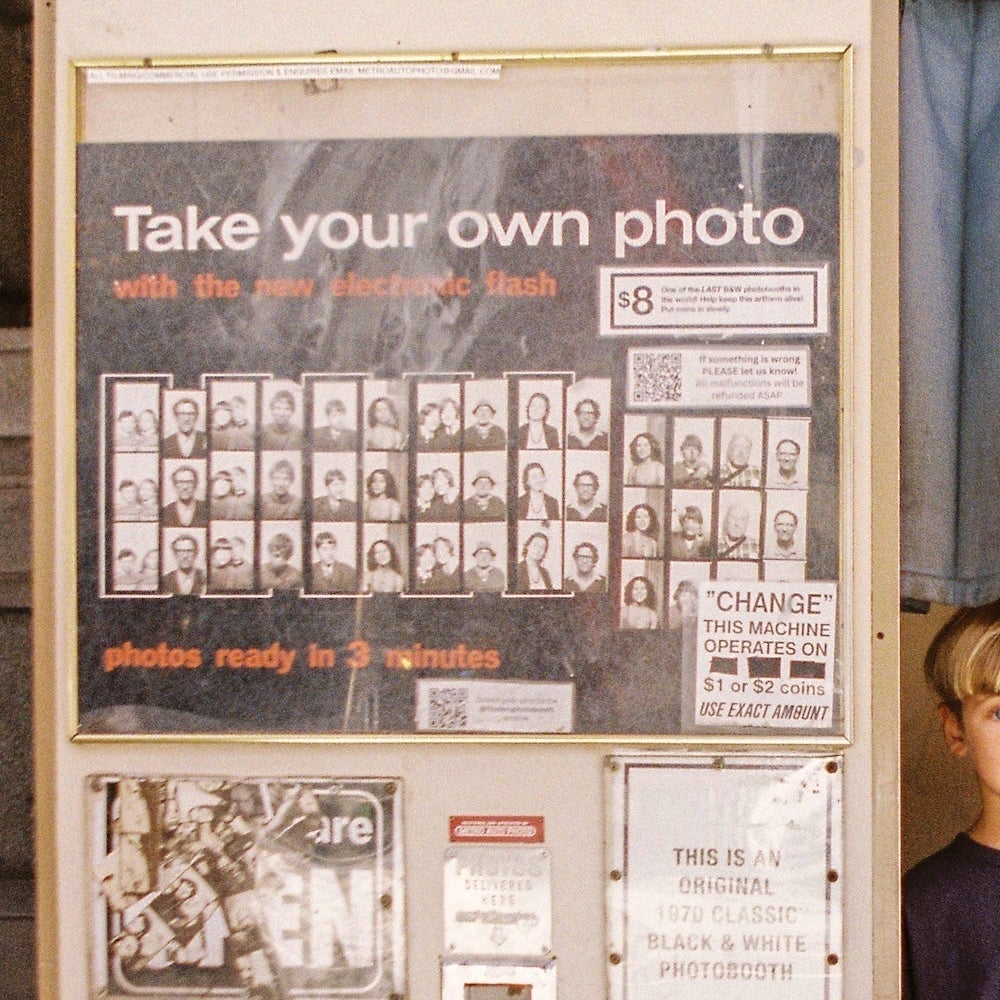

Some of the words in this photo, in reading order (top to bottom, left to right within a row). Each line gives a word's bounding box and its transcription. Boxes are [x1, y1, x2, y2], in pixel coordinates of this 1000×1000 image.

[113, 205, 260, 252] Take
[280, 210, 428, 261] your
[447, 210, 590, 248] own
[615, 199, 805, 258] photo
[113, 273, 178, 298] with
[194, 272, 241, 298] the
[254, 276, 315, 297] new
[331, 270, 471, 296] electronic
[486, 269, 558, 297] flash
[618, 285, 653, 315] $8
[719, 296, 738, 304] keep
[708, 355, 759, 365] something
[761, 355, 769, 363] is
[770, 356, 801, 365] wrong
[702, 367, 738, 375] PLEASE
[741, 367, 753, 375] let
[769, 367, 798, 375] know!
[710, 379, 771, 387] malfunctions
[774, 379, 790, 387] will
[792, 379, 804, 387] be
[711, 391, 755, 399] refunded
[706, 591, 833, 615] "CHANGE"
[704, 620, 743, 634] THIS
[749, 621, 830, 637] MACHINE
[704, 639, 796, 655] OPERATES
[802, 642, 827, 656] ON
[103, 641, 201, 671] photos
[215, 642, 295, 675] ready
[308, 643, 335, 668] in
[347, 640, 370, 669] 3
[385, 644, 500, 670] minutes
[704, 678, 723, 692] $1
[731, 682, 748, 692] or
[753, 679, 774, 694] $2
[780, 681, 825, 696] coins
[700, 702, 726, 717] USE
[728, 703, 771, 718] EXACT
[772, 704, 829, 721] AMOUNT
[673, 848, 718, 867] THIS
[727, 848, 745, 867] IS
[753, 850, 781, 867] AN
[679, 877, 776, 895] ORIGINAL
[711, 905, 798, 923] CLASSIC
[648, 934, 712, 951] BLACK
[721, 935, 735, 951] &
[742, 935, 807, 953] WHITE
[659, 962, 794, 981] PHOTOBOOTH
